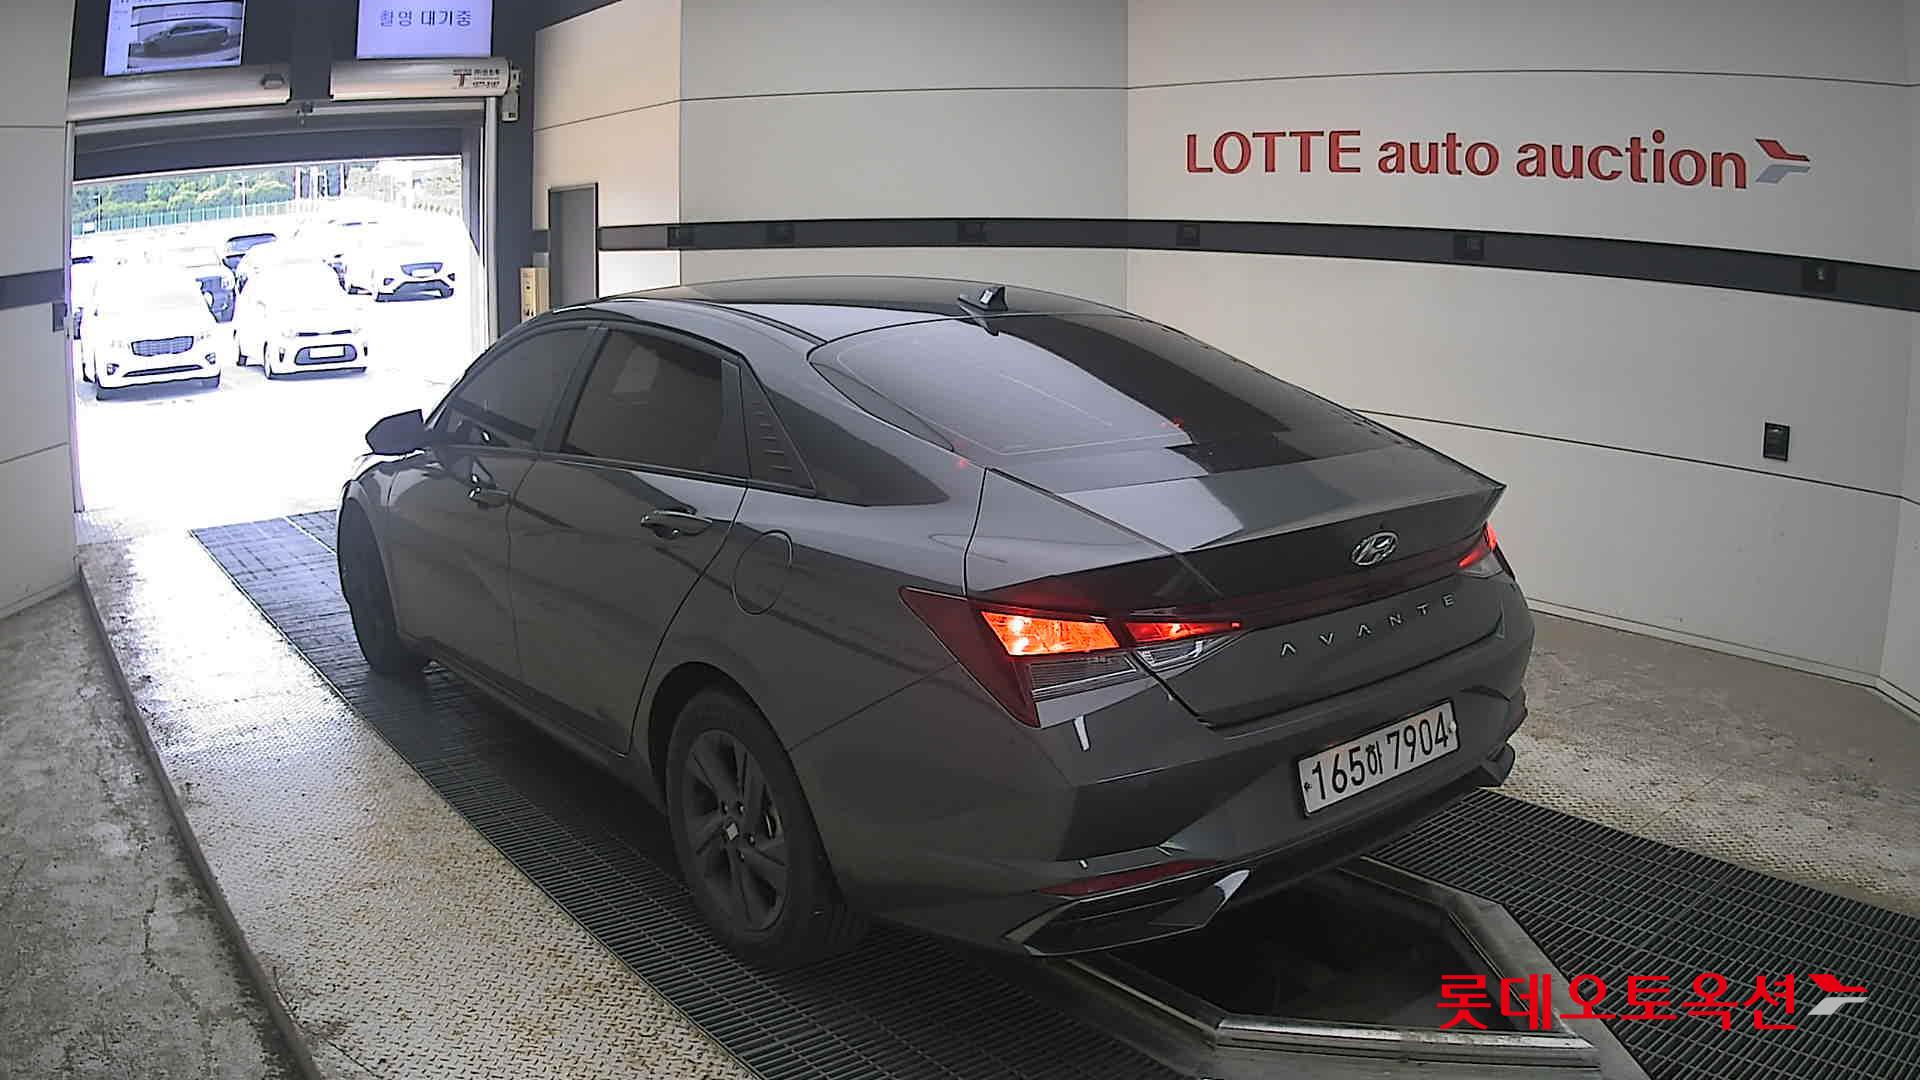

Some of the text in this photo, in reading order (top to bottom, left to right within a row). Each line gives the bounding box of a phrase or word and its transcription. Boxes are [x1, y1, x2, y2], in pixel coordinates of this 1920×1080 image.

[420, 9, 472, 27] 대기중
[1186, 129, 1748, 190] LOTTE auto auction
[1280, 594, 1455, 657] AVANTE
[1311, 711, 1449, 800] 165하 7904
